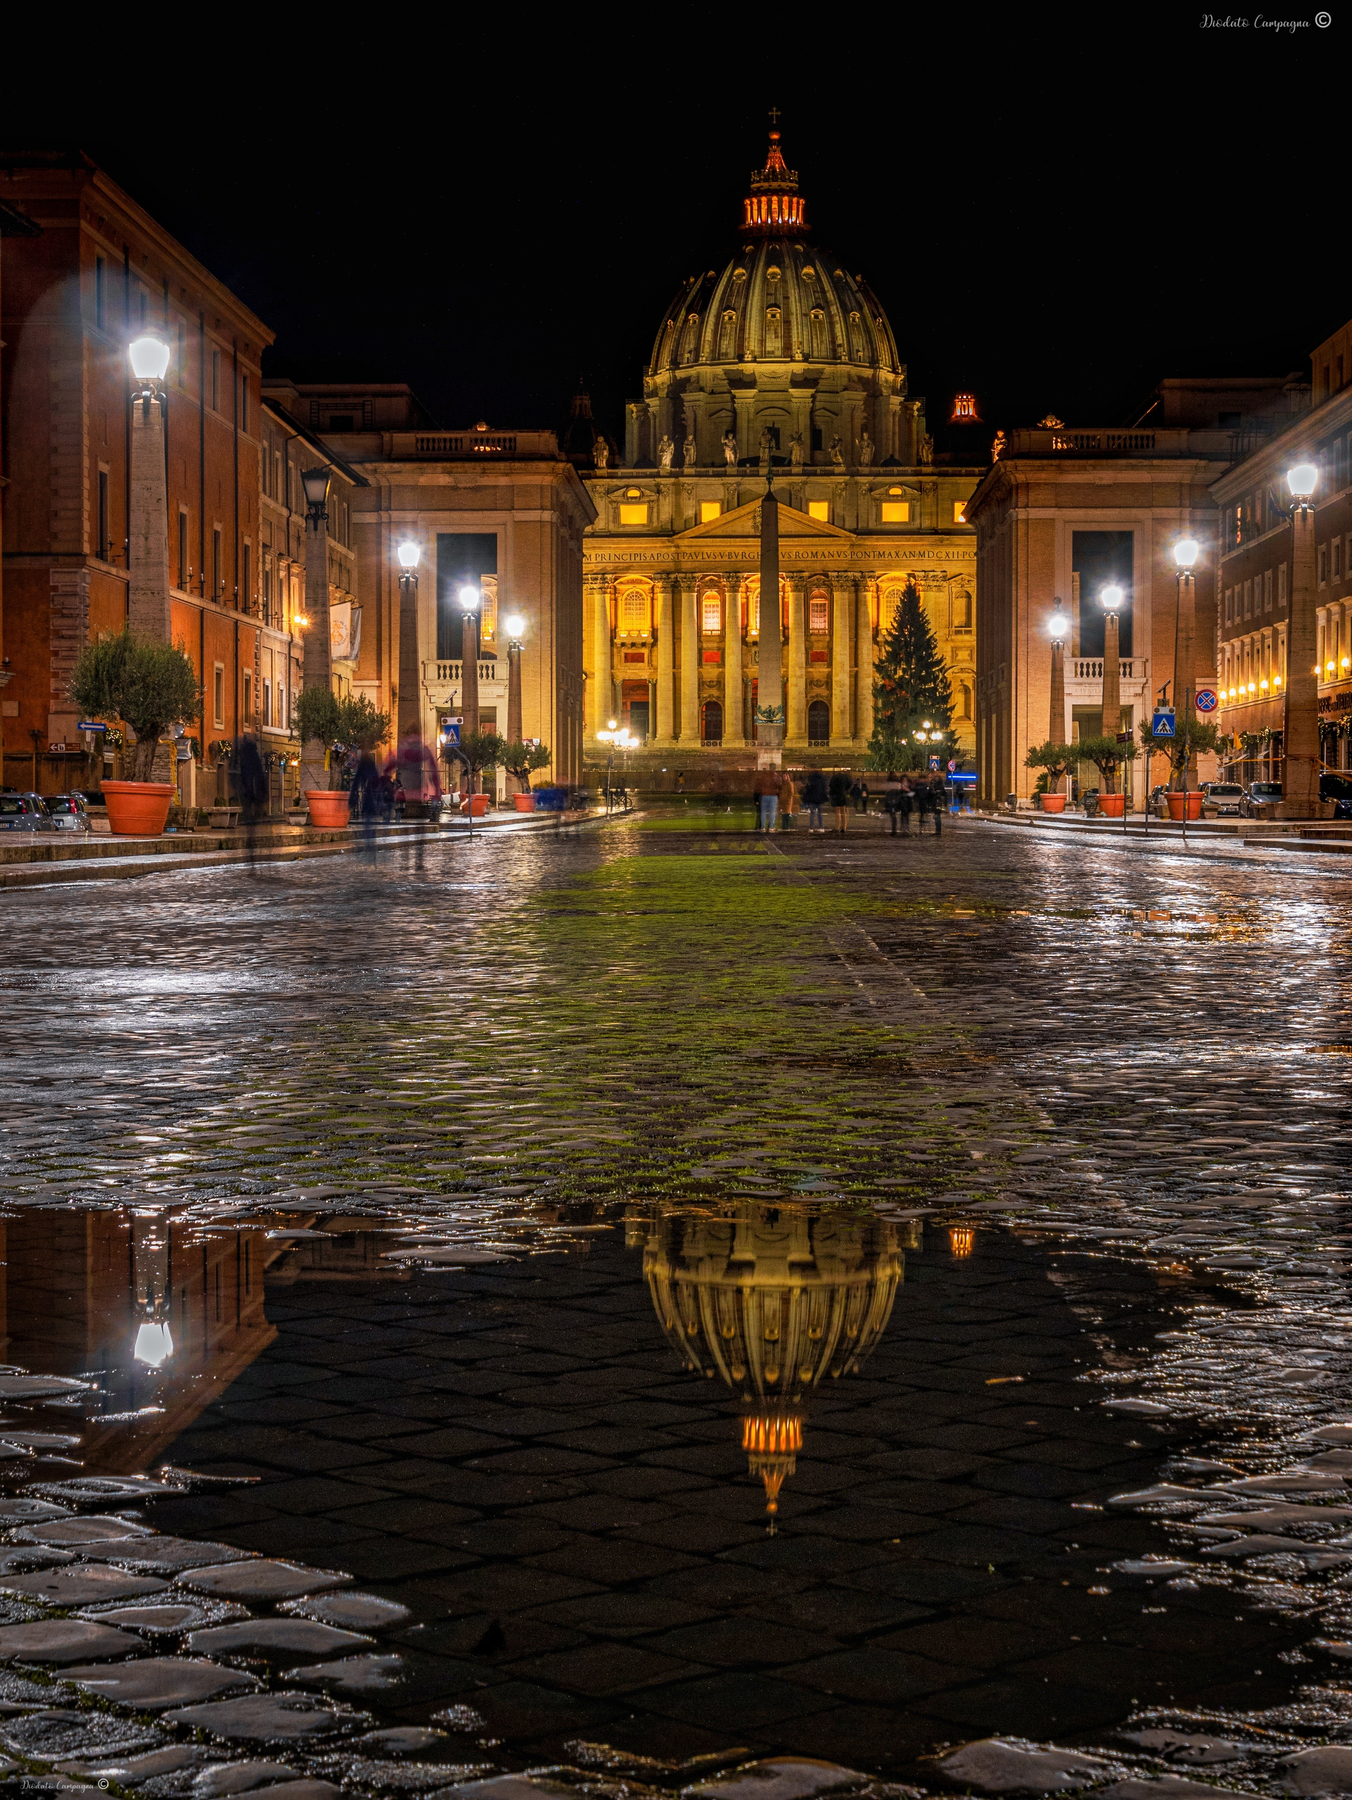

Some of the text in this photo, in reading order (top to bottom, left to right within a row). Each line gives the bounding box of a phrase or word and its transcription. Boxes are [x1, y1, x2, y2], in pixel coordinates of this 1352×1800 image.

[595, 552, 648, 561] PRINCIPIS
[682, 551, 717, 560] PAVLVS
[795, 551, 848, 560] ROMANVS
[917, 550, 960, 559] MDCXII
